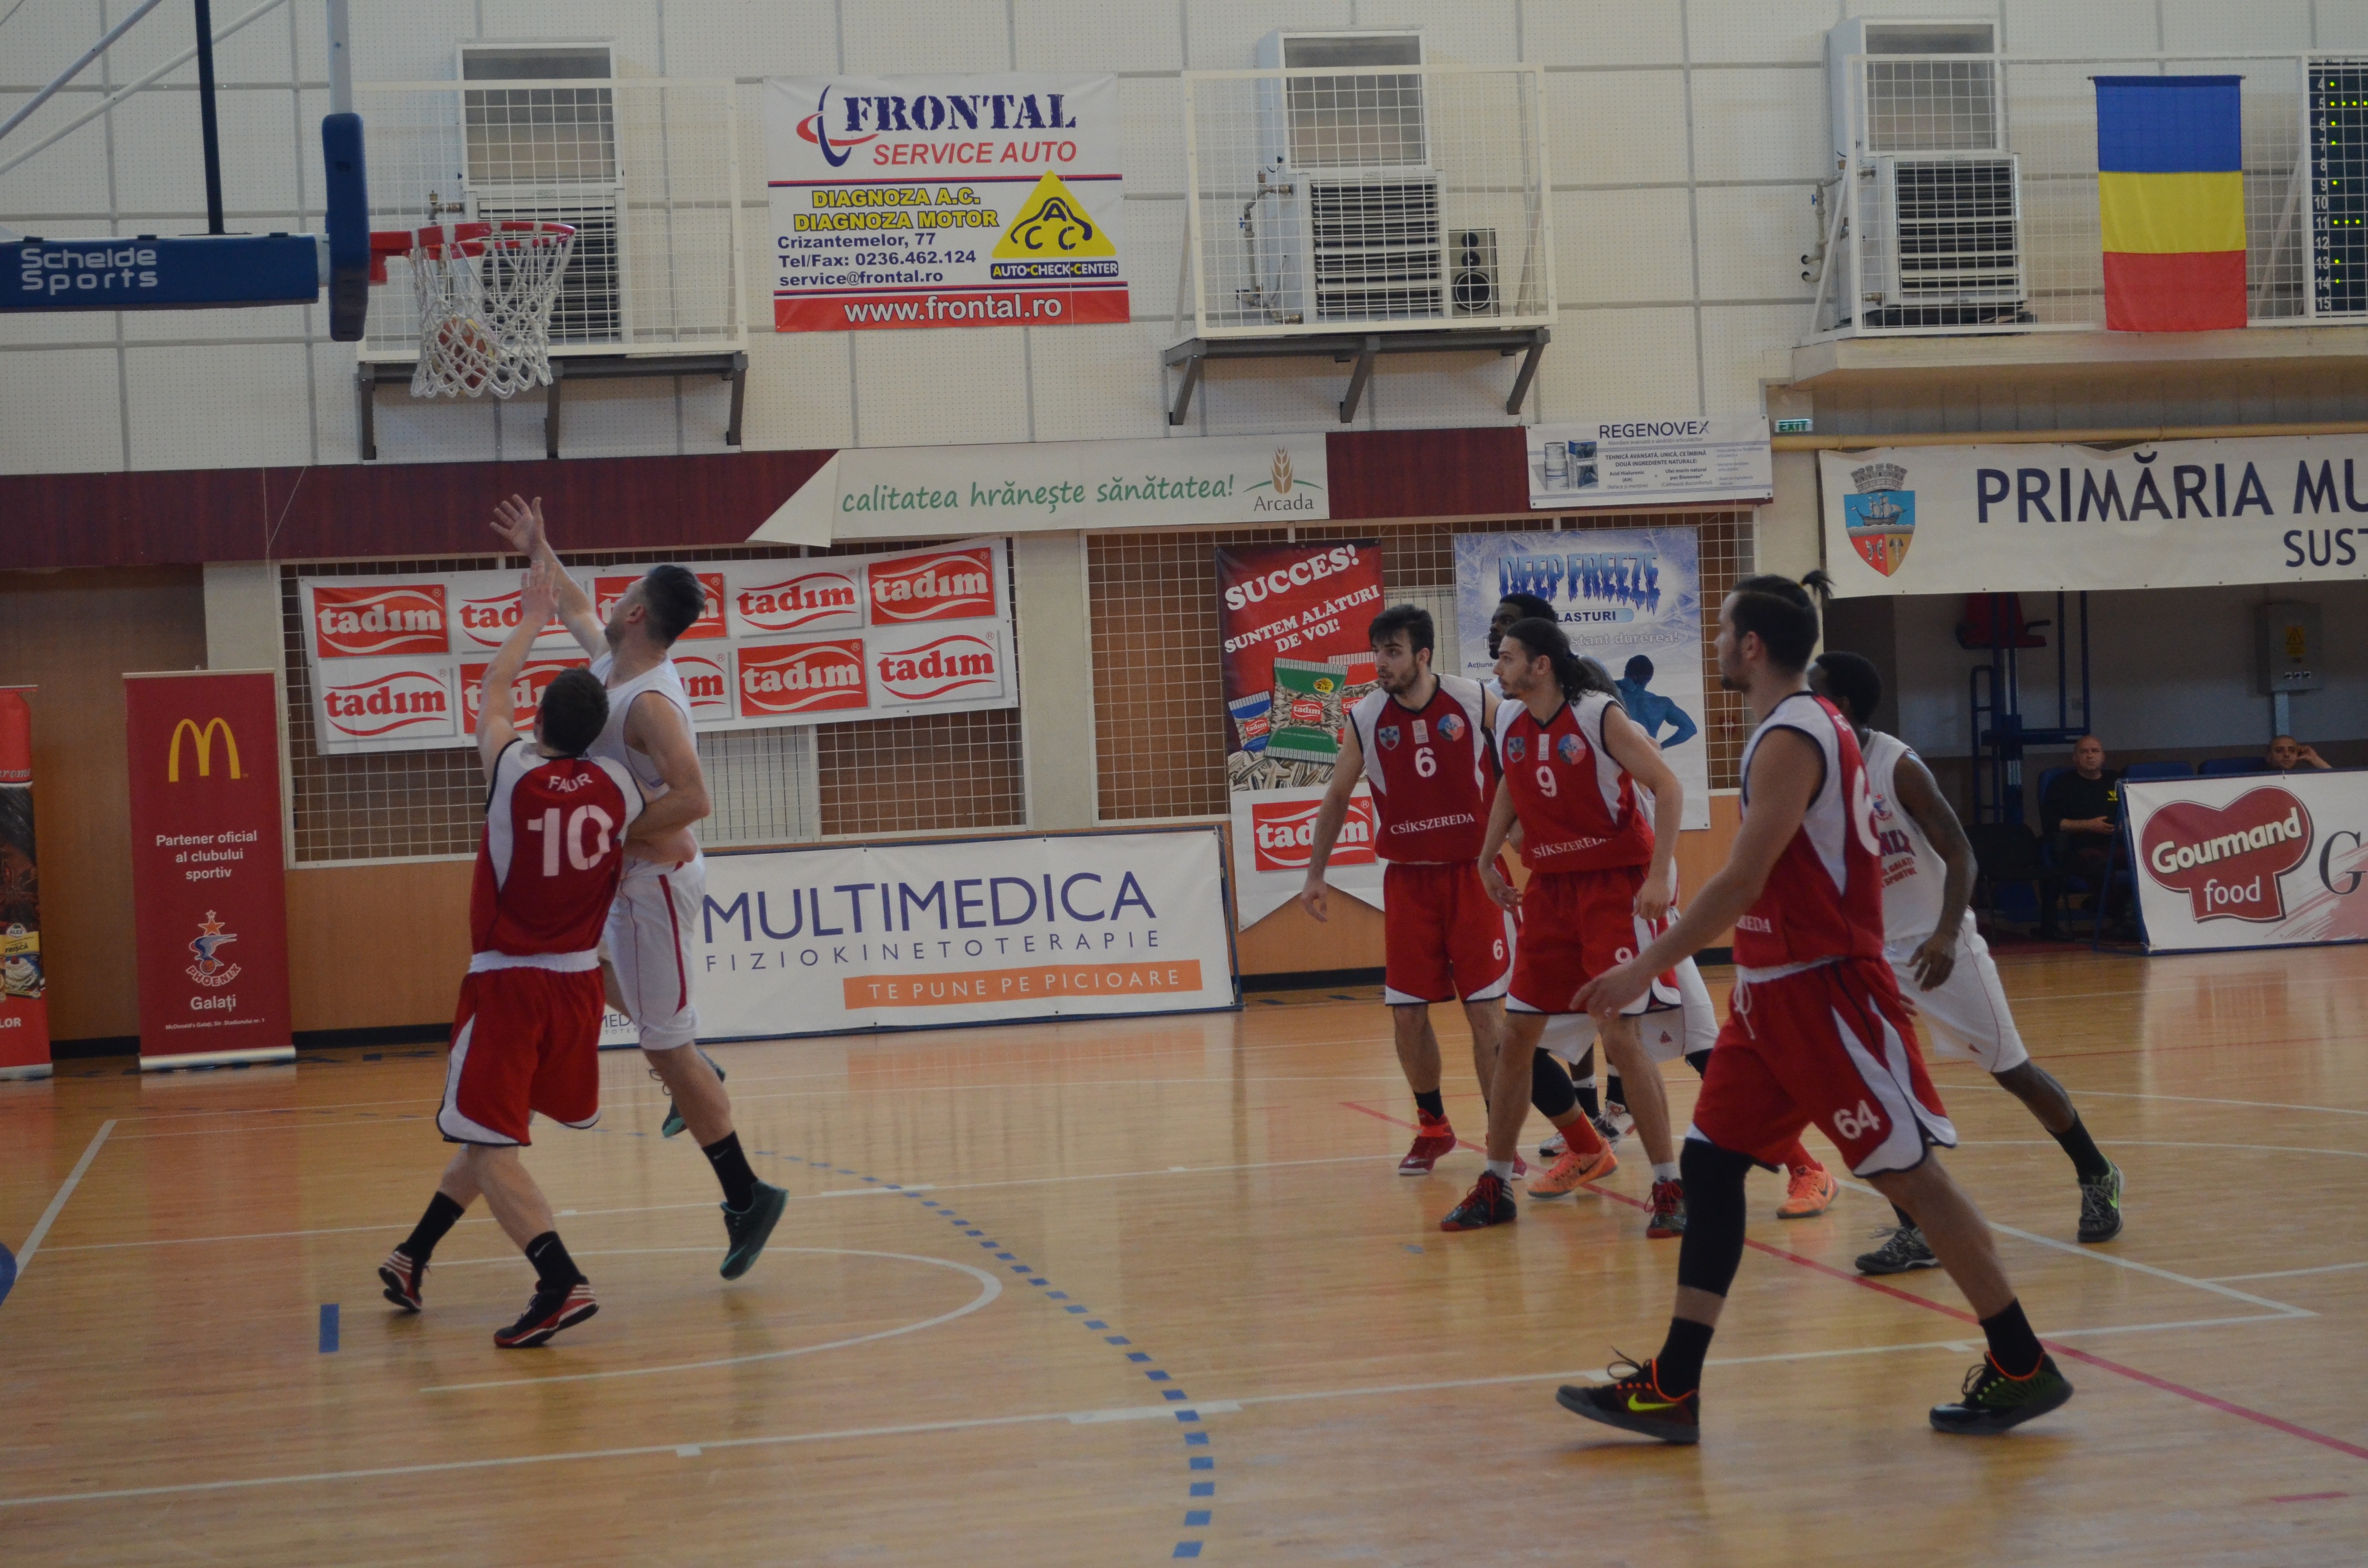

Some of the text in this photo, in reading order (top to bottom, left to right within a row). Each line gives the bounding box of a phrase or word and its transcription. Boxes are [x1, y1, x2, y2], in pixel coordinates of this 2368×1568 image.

[2318, 77, 2324, 90] 4
[844, 94, 1077, 132] FRONTAL
[2319, 98, 2325, 110] 5
[2319, 118, 2325, 131] 6
[873, 141, 1077, 165] SERVICE AUTO
[2319, 138, 2326, 150] 7
[2319, 158, 2327, 171] 8
[2320, 178, 2327, 191] 9
[812, 188, 981, 208] DIAGNOZA A.C.
[2314, 196, 2328, 209] 10
[794, 210, 1000, 232] DIAGNOZA MOTOR
[2316, 216, 2329, 229] 11
[778, 233, 936, 249] Crizantemelor, 77
[2315, 236, 2329, 249] 12
[21, 248, 157, 269] Schelde
[778, 250, 976, 268] Tel/Fax: 0236.462.124
[2316, 256, 2330, 269] 13
[22, 269, 158, 295] Sports
[779, 270, 943, 286] service@frontal.ro
[2317, 277, 2330, 290] 14
[844, 294, 1061, 322] www.frontal.ro
[2317, 297, 2331, 310] 15
[1600, 421, 1709, 439] REGENOVEX
[842, 475, 1234, 514] calitatea hrănește sănătatea!
[1976, 451, 2274, 524] PRIMĂRIA
[1253, 495, 1314, 513] Arcada
[1225, 544, 1359, 611] SUCCES!
[1567, 551, 1661, 616] FREEZE
[1225, 585, 1380, 653] SUNTEM ALĂTURI
[1557, 612, 1616, 623] LASTURI
[1275, 619, 1340, 652] DE VOI!
[1570, 635, 1610, 647] stant
[1415, 747, 1437, 778] 6
[548, 773, 593, 793] FAUR
[1537, 765, 1557, 797] 9
[1390, 813, 1475, 834] CSÍKSZEREDA
[156, 831, 257, 846] Partener oficial
[527, 805, 613, 877] 10
[2152, 807, 2302, 873] Gourmand
[175, 848, 243, 863] al clubului
[186, 867, 232, 881] sportiv
[2204, 876, 2260, 912] food
[703, 870, 1157, 944] MULTIMEDICA
[1492, 939, 1503, 961] 6
[186, 963, 241, 987] PHOENIX
[868, 969, 1180, 1001] TE PUNE PE PICIOARE
[1833, 1099, 1880, 1139] 64
